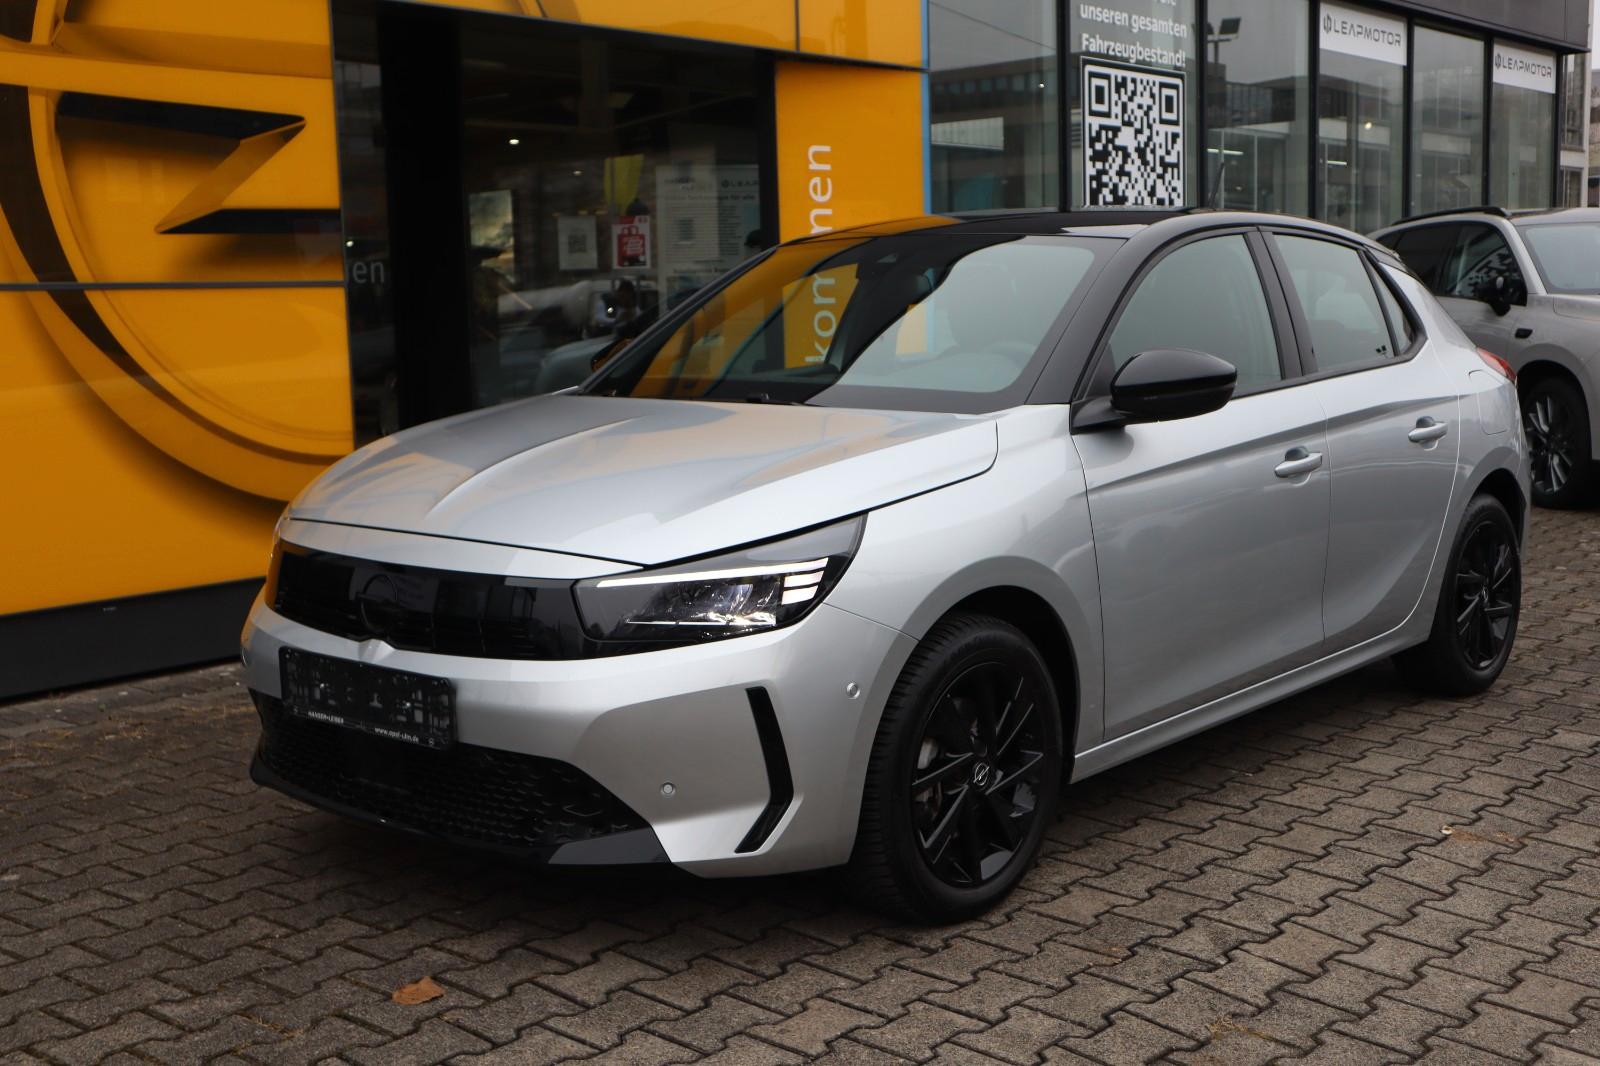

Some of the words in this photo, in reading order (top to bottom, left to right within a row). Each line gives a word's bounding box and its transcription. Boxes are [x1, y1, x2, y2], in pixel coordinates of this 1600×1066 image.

[1080, 4, 1129, 26] unseren
[1131, 13, 1187, 39] gesamten
[1333, 19, 1402, 47] LEAPMOTOR
[1081, 33, 1186, 68] Fahrzeugbestand!
[1502, 55, 1553, 78] LEAPMOTOR
